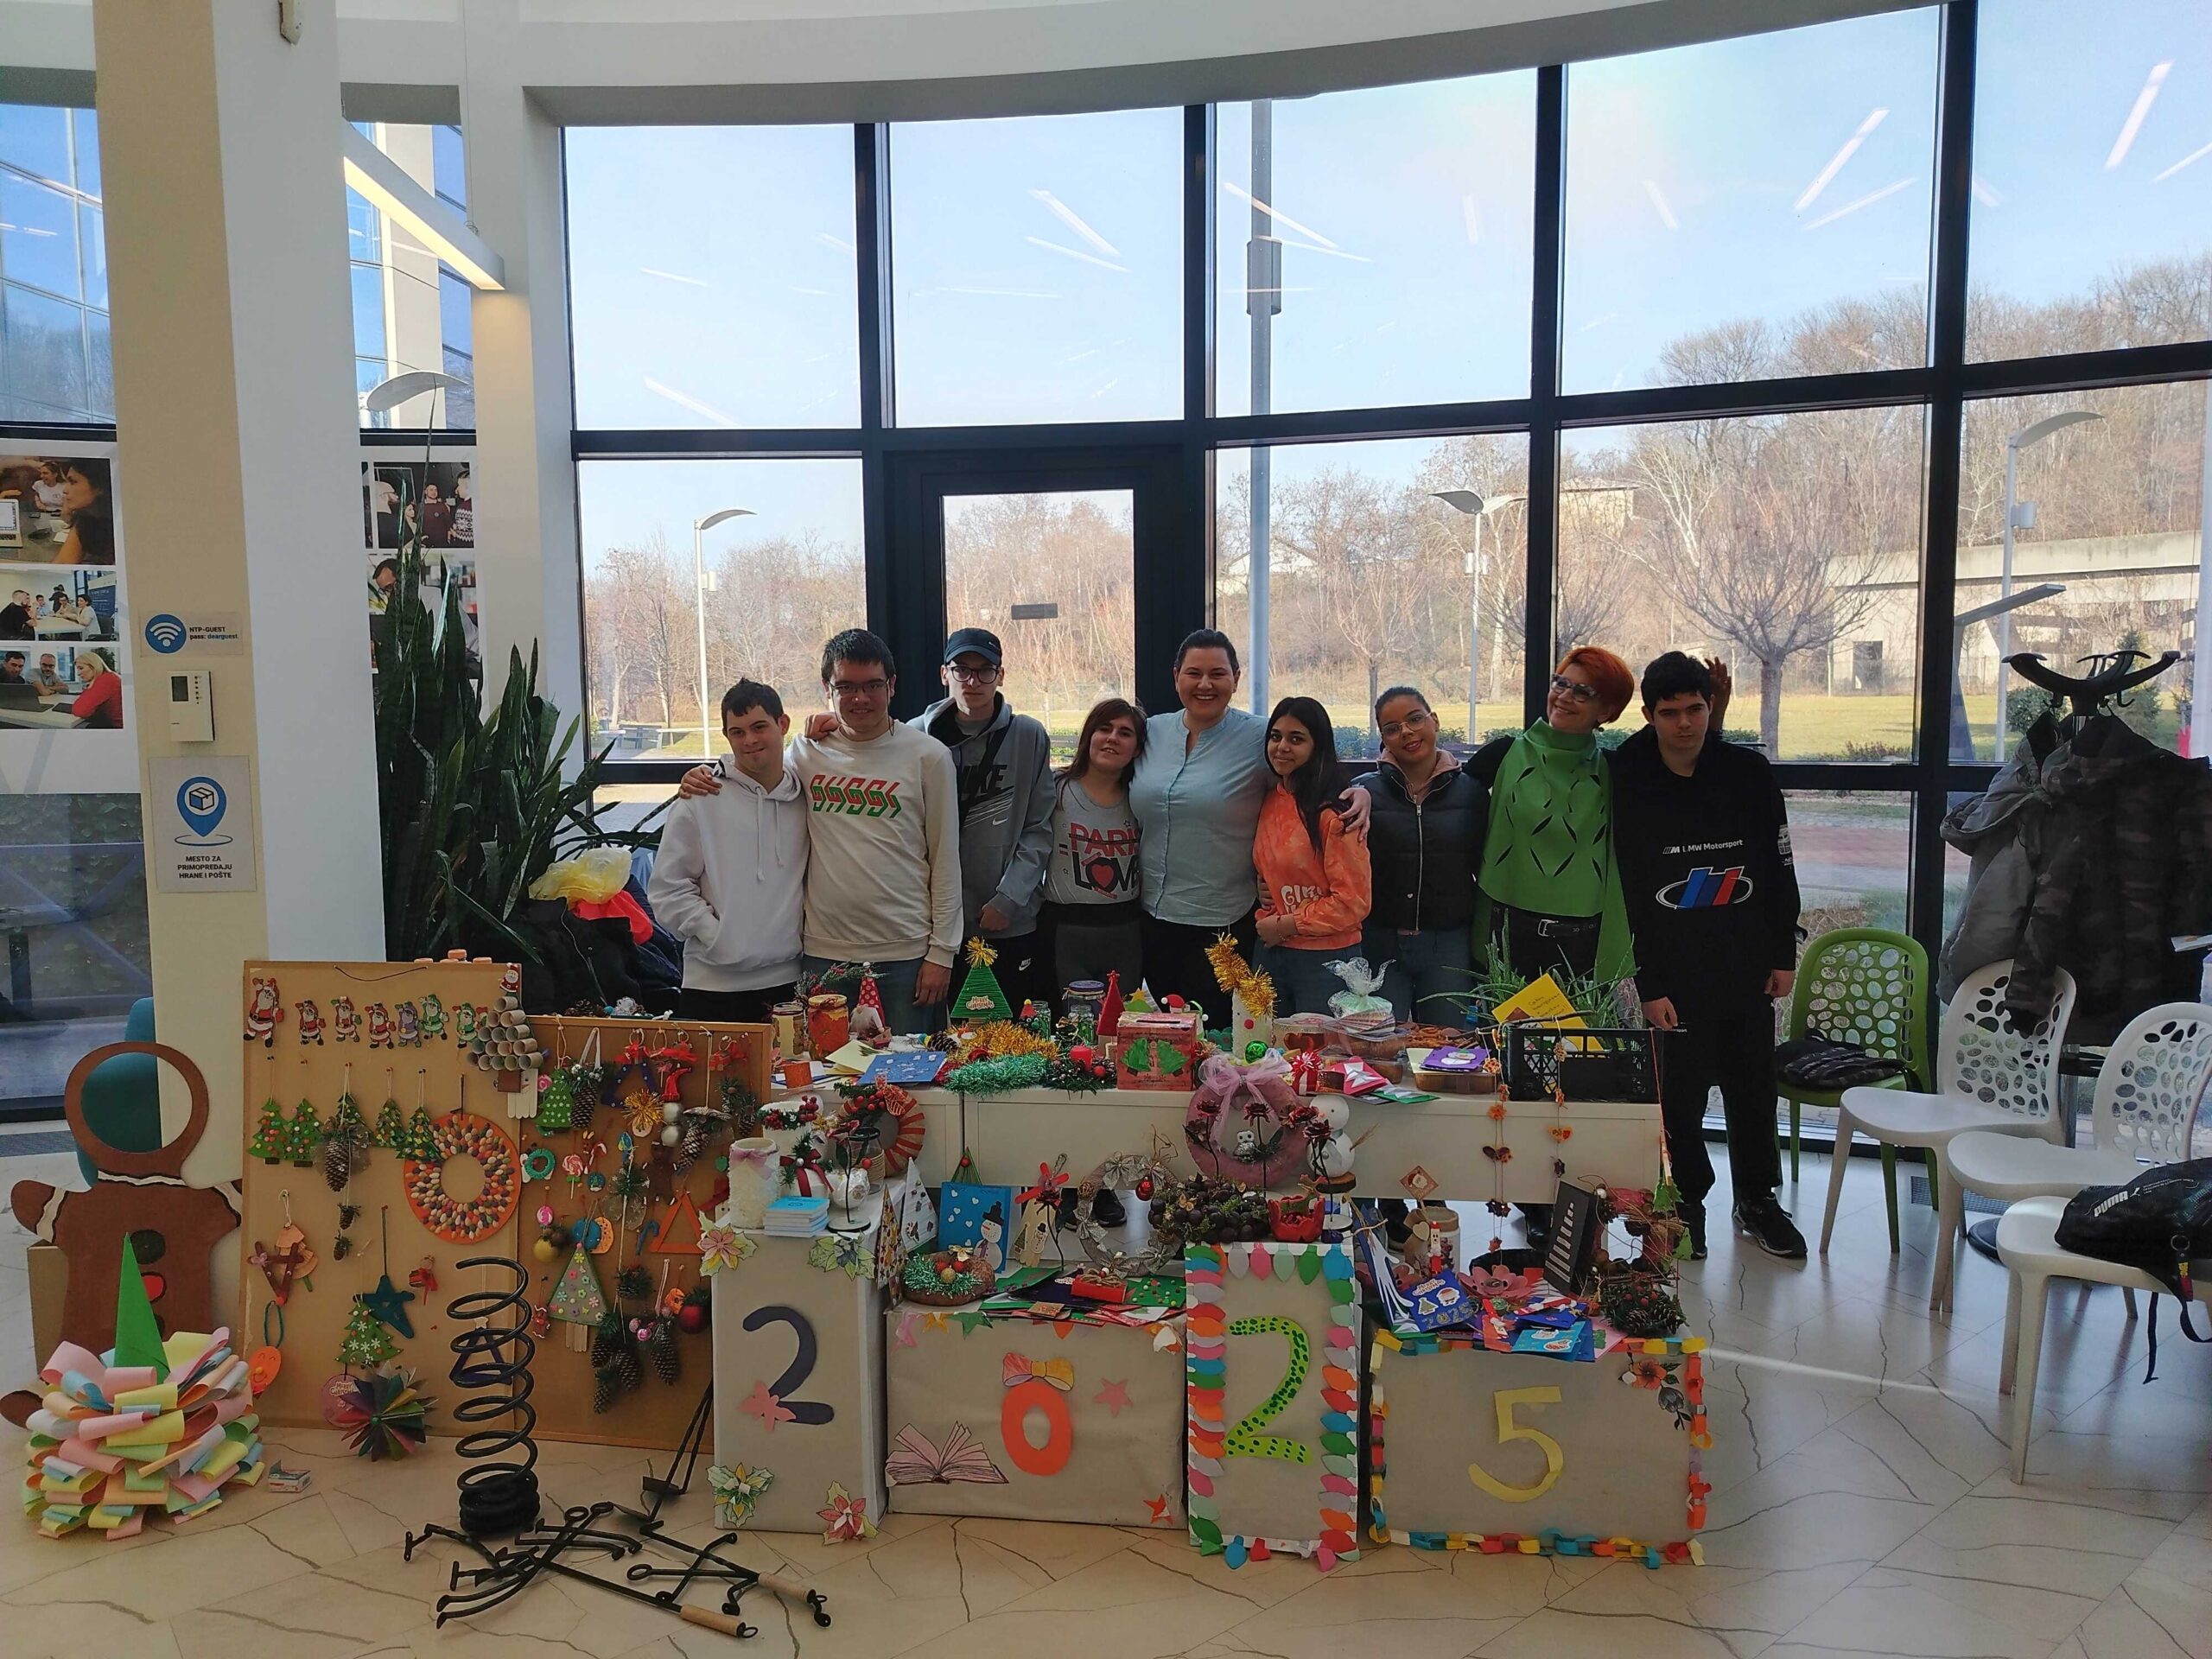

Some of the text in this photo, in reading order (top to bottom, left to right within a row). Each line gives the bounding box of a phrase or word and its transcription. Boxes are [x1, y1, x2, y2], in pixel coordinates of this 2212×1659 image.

[1703, 839, 1743, 850] Motorsport
[2094, 1191, 2128, 1217] PUMA
[742, 1306, 835, 1425] 2
[1224, 1316, 1313, 1465] 2
[1469, 1386, 1564, 1503] 5
